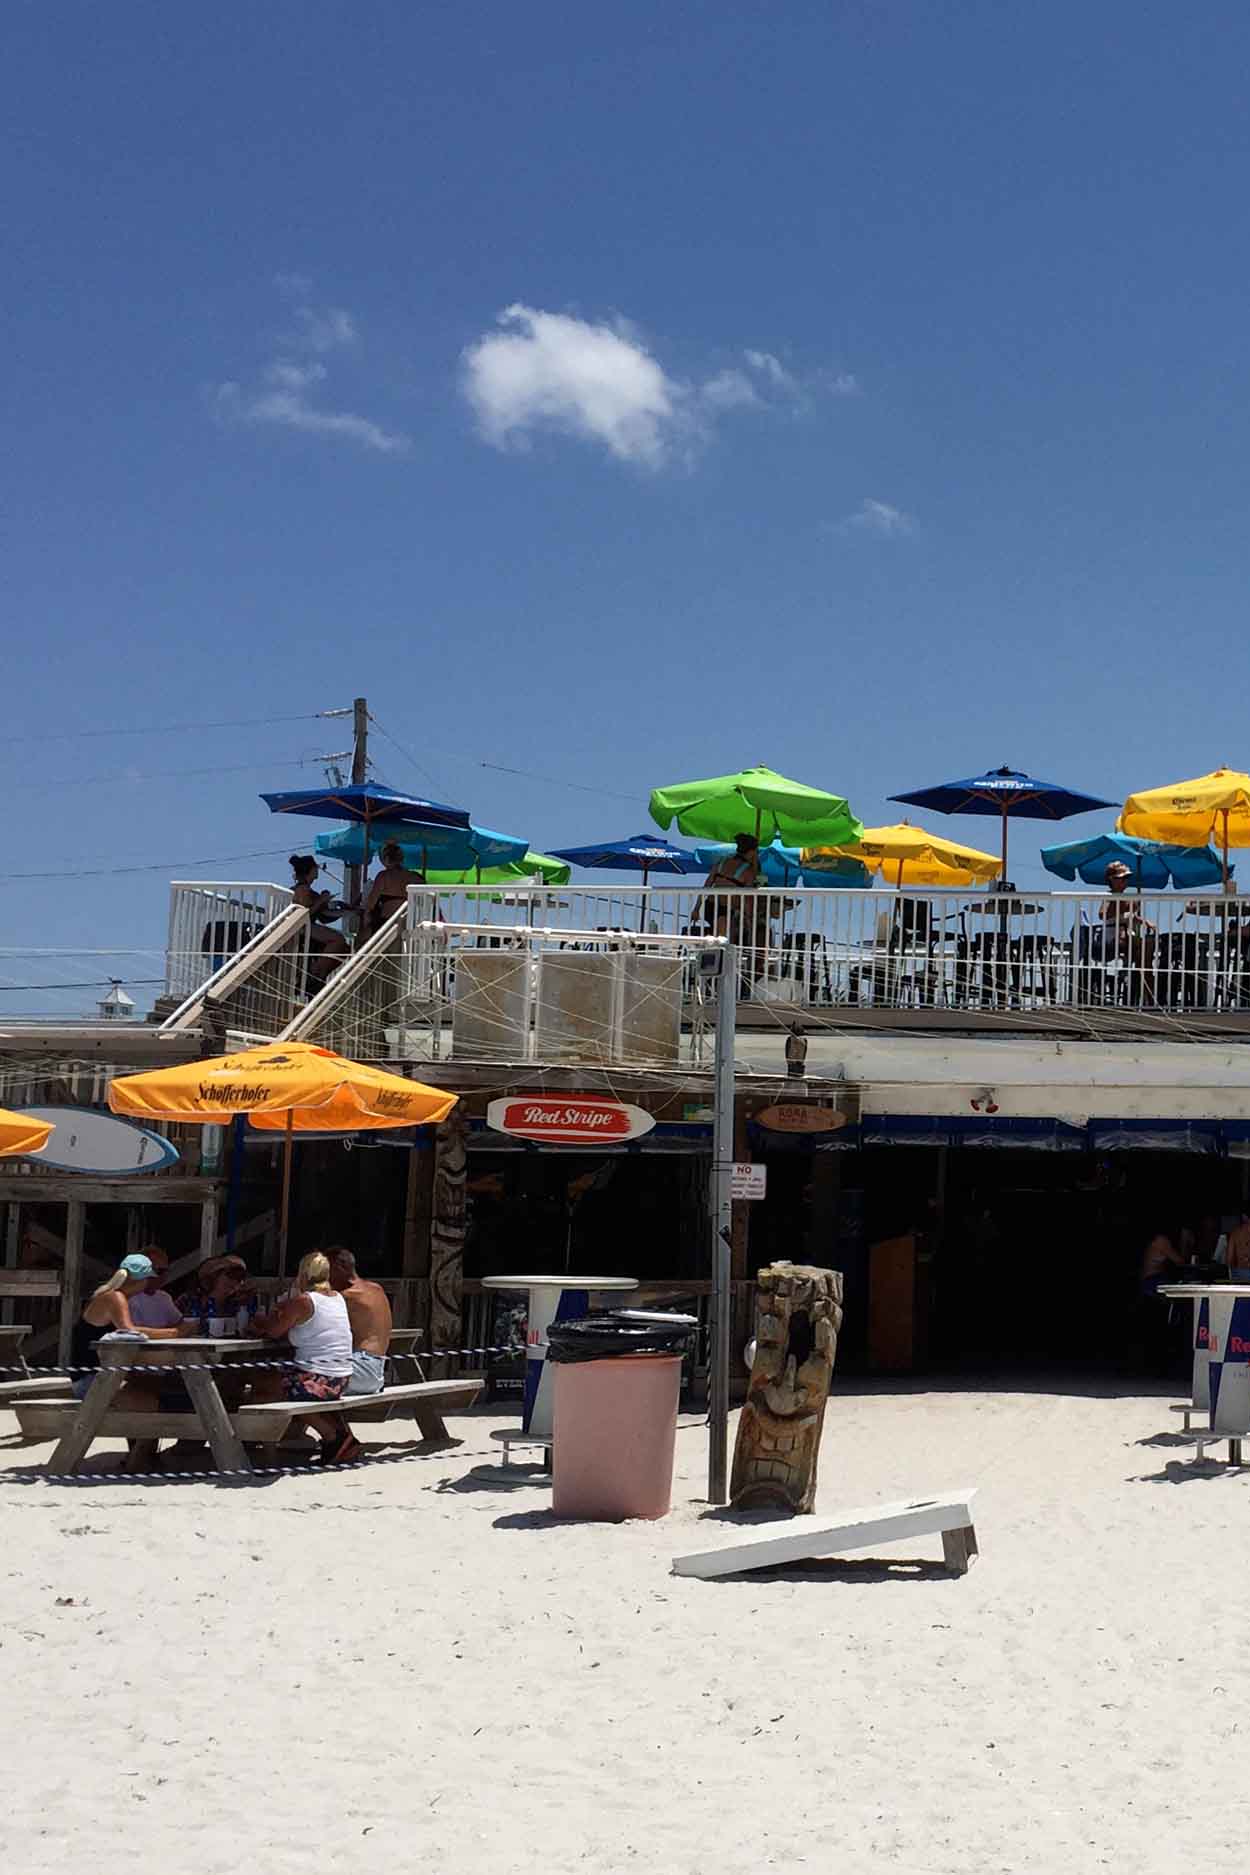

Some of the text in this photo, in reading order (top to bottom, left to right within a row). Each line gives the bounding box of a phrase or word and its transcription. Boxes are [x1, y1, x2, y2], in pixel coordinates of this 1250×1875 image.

[523, 1106, 612, 1127] Red Stripe
[736, 1166, 752, 1174] NO
